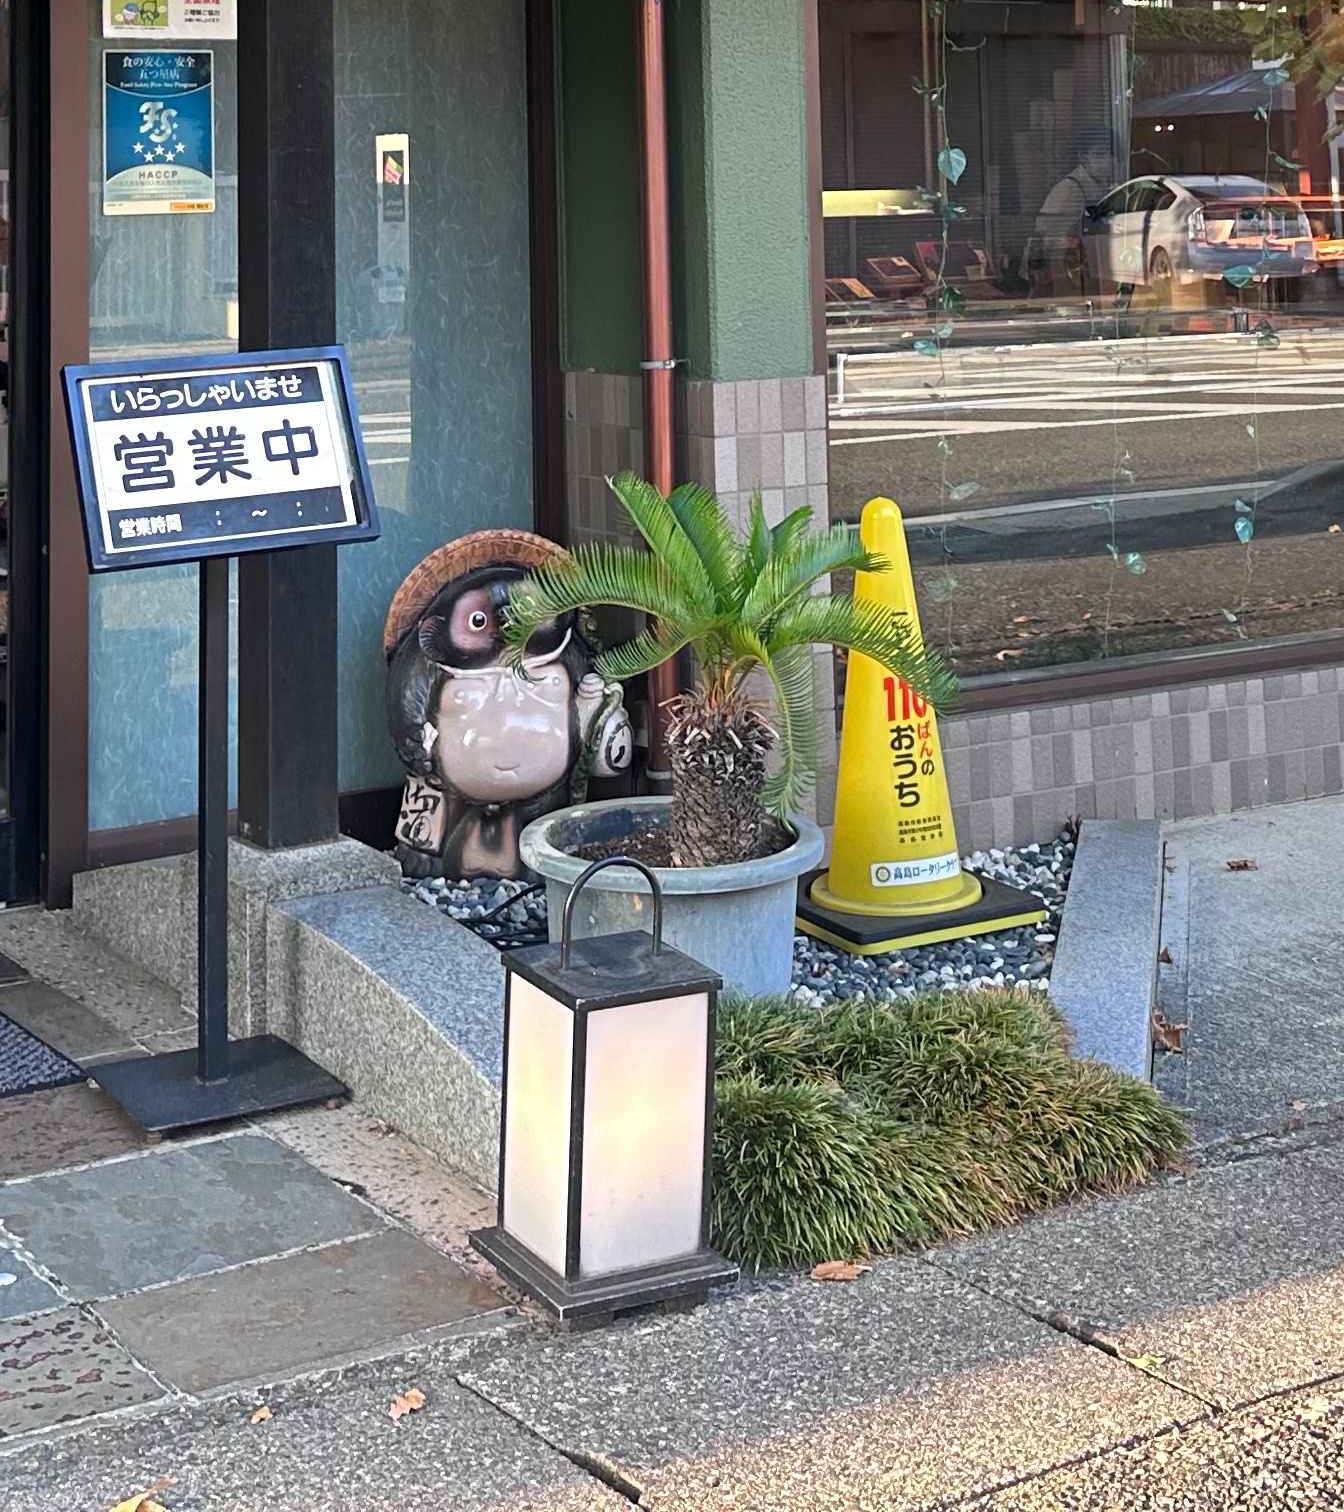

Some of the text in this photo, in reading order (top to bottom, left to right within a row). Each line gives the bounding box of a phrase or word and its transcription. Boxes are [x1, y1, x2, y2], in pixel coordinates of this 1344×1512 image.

[139, 170, 178, 180] HACCP
[110, 374, 303, 414] いらっしゃいませ
[113, 418, 319, 494] 営業中
[118, 513, 183, 539] 営業時間
[889, 724, 921, 808] おうち
